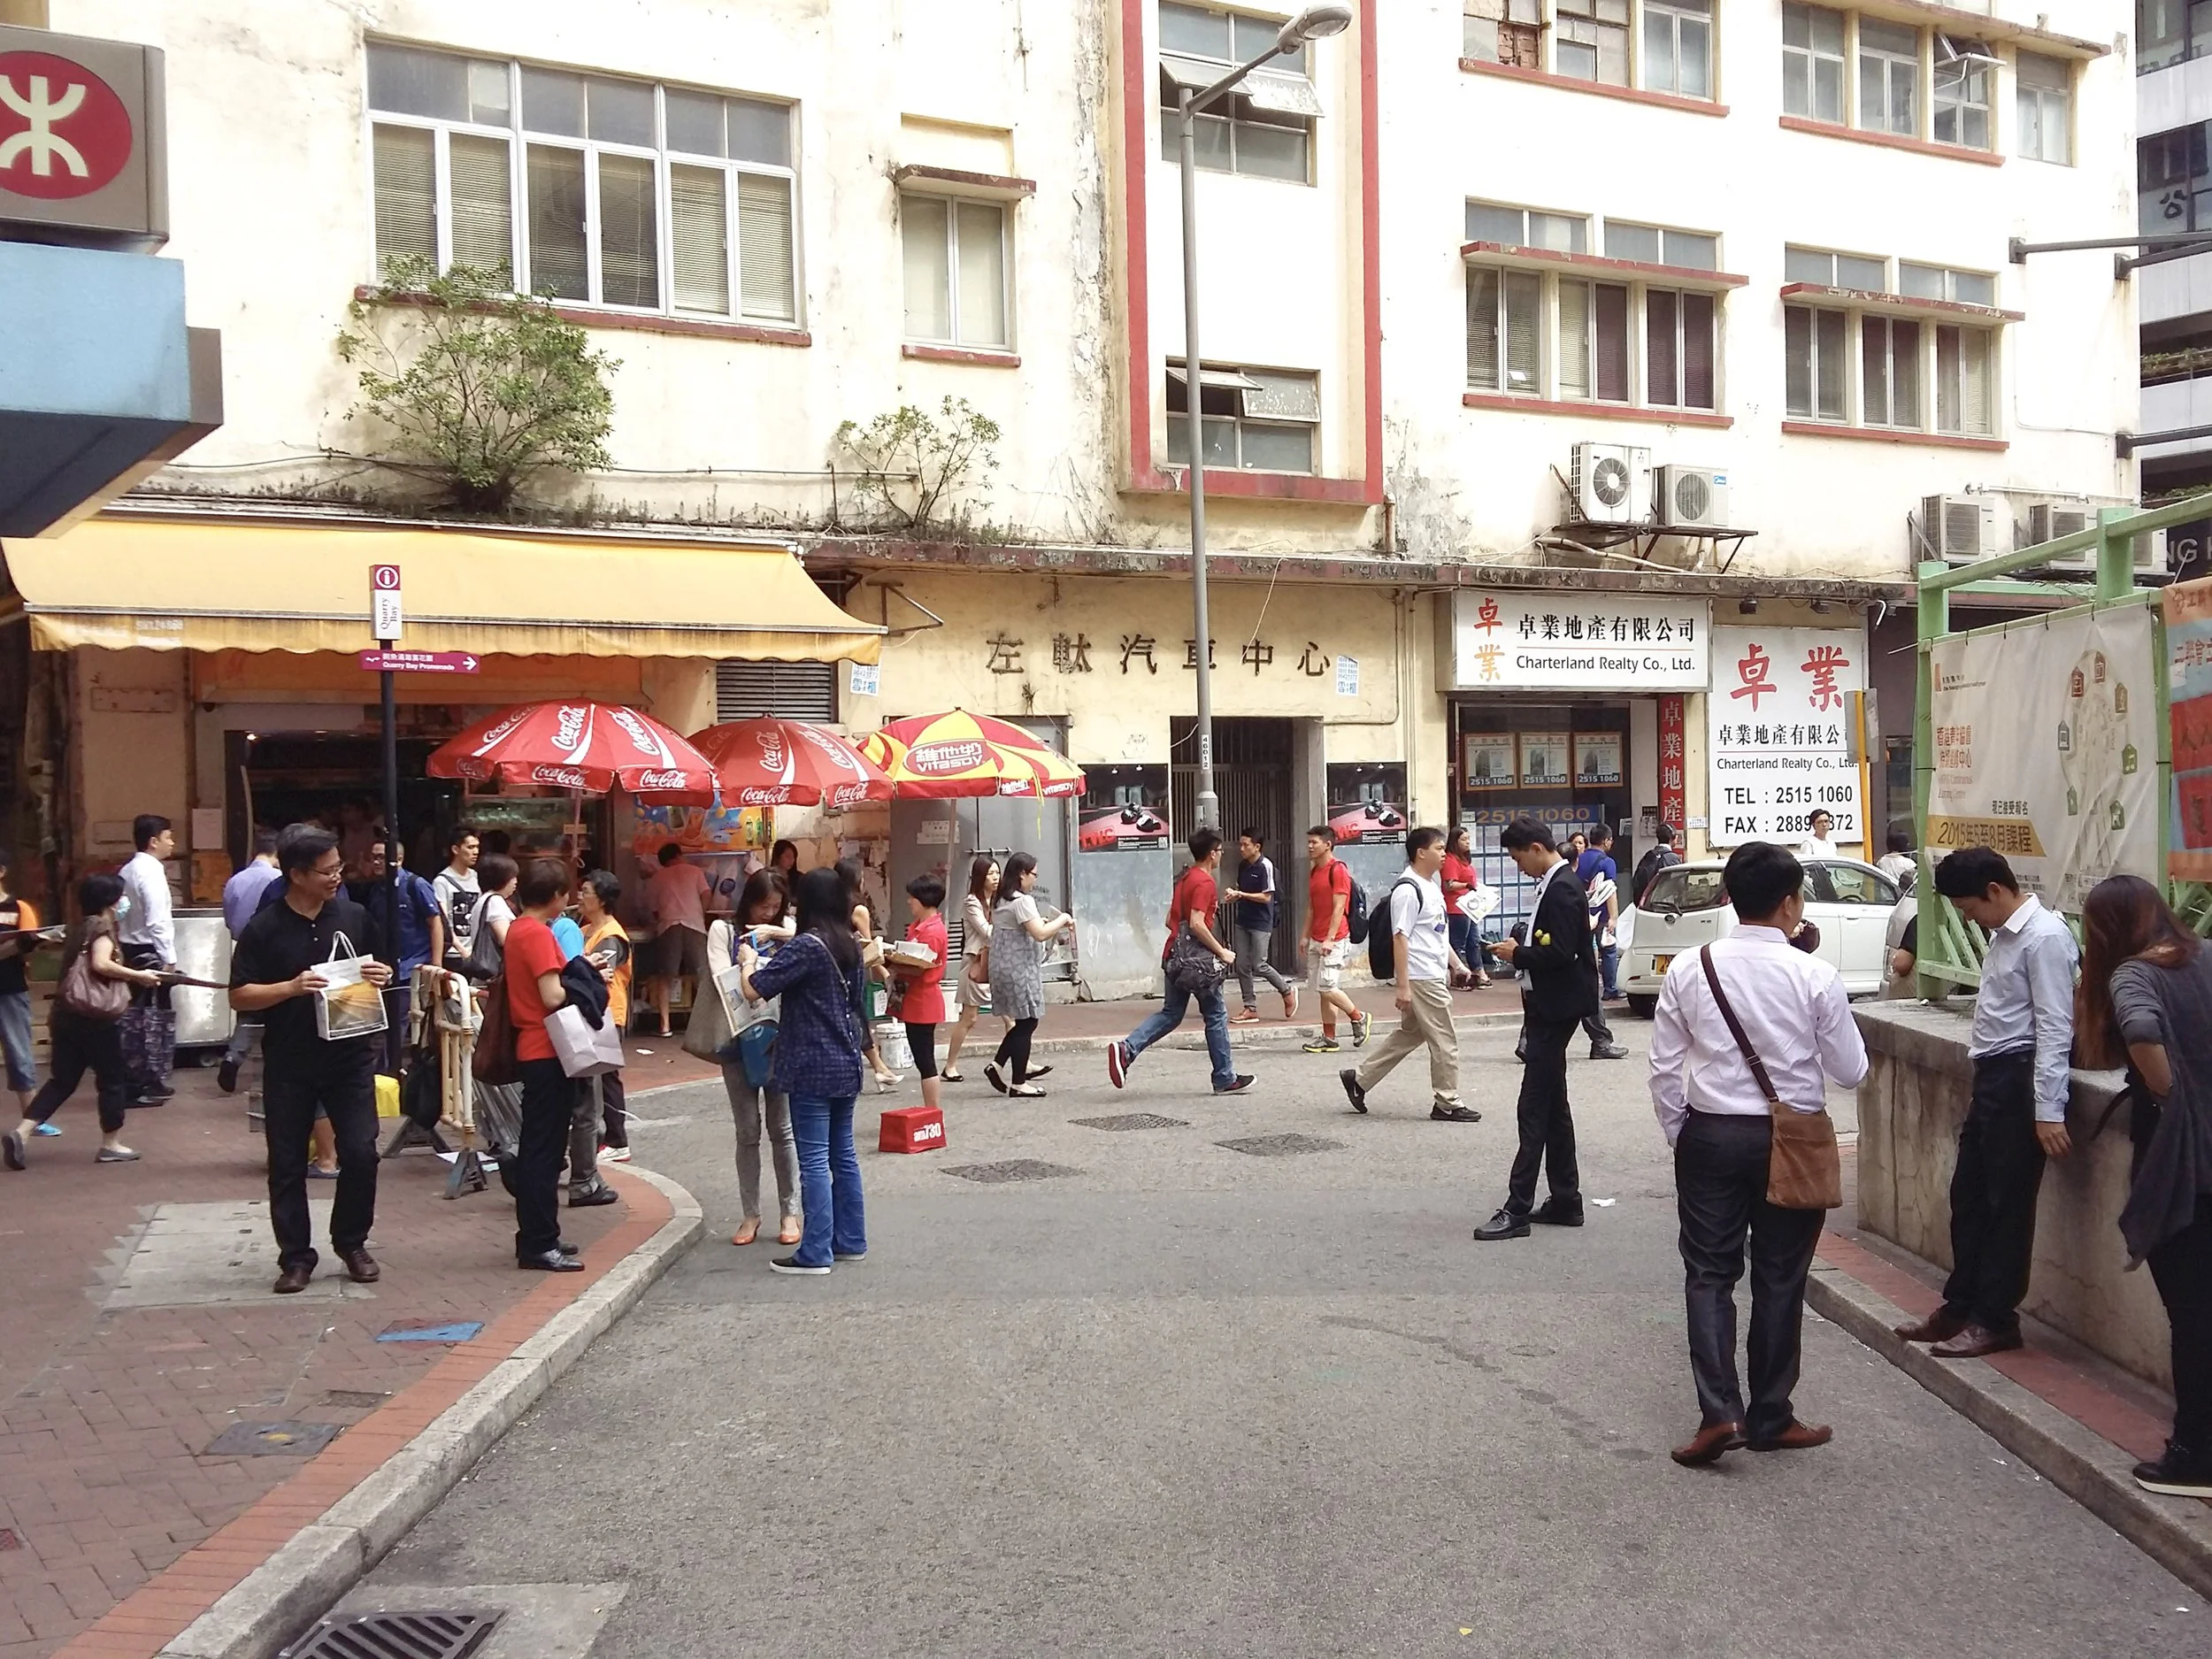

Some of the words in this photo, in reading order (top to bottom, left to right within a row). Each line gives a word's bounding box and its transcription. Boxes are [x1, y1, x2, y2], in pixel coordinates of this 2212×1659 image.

[380, 597, 390, 630] Quarry
[390, 605, 399, 622] Bay
[1516, 613, 1694, 642] 卓業地產有限公司
[1473, 597, 1505, 682] 卓業
[382, 661, 405, 670] Quarry
[1516, 655, 1594, 670] Charterland
[1600, 657, 1638, 673] Realty
[1643, 657, 1667, 672] Co.,
[1671, 657, 1695, 671] Ltd.
[1730, 643, 1850, 712] 卓業
[916, 741, 983, 763] 維他奶
[917, 754, 983, 772] vitasoy
[1663, 701, 1682, 823] 卓業地產
[1717, 757, 1778, 770] Charterland
[1782, 757, 1812, 772] Realty
[1816, 757, 1835, 770] Co.,
[1471, 777, 1491, 786] 2515
[1724, 787, 1756, 804] TEL
[1776, 787, 1812, 803] 2515
[1818, 786, 1853, 803] 1060
[1477, 810, 1530, 824] 2515
[1535, 808, 1590, 821] 1060
[1724, 817, 1757, 833] FAX
[1776, 815, 1811, 833] 2889
[913, 1122, 941, 1142] am730
